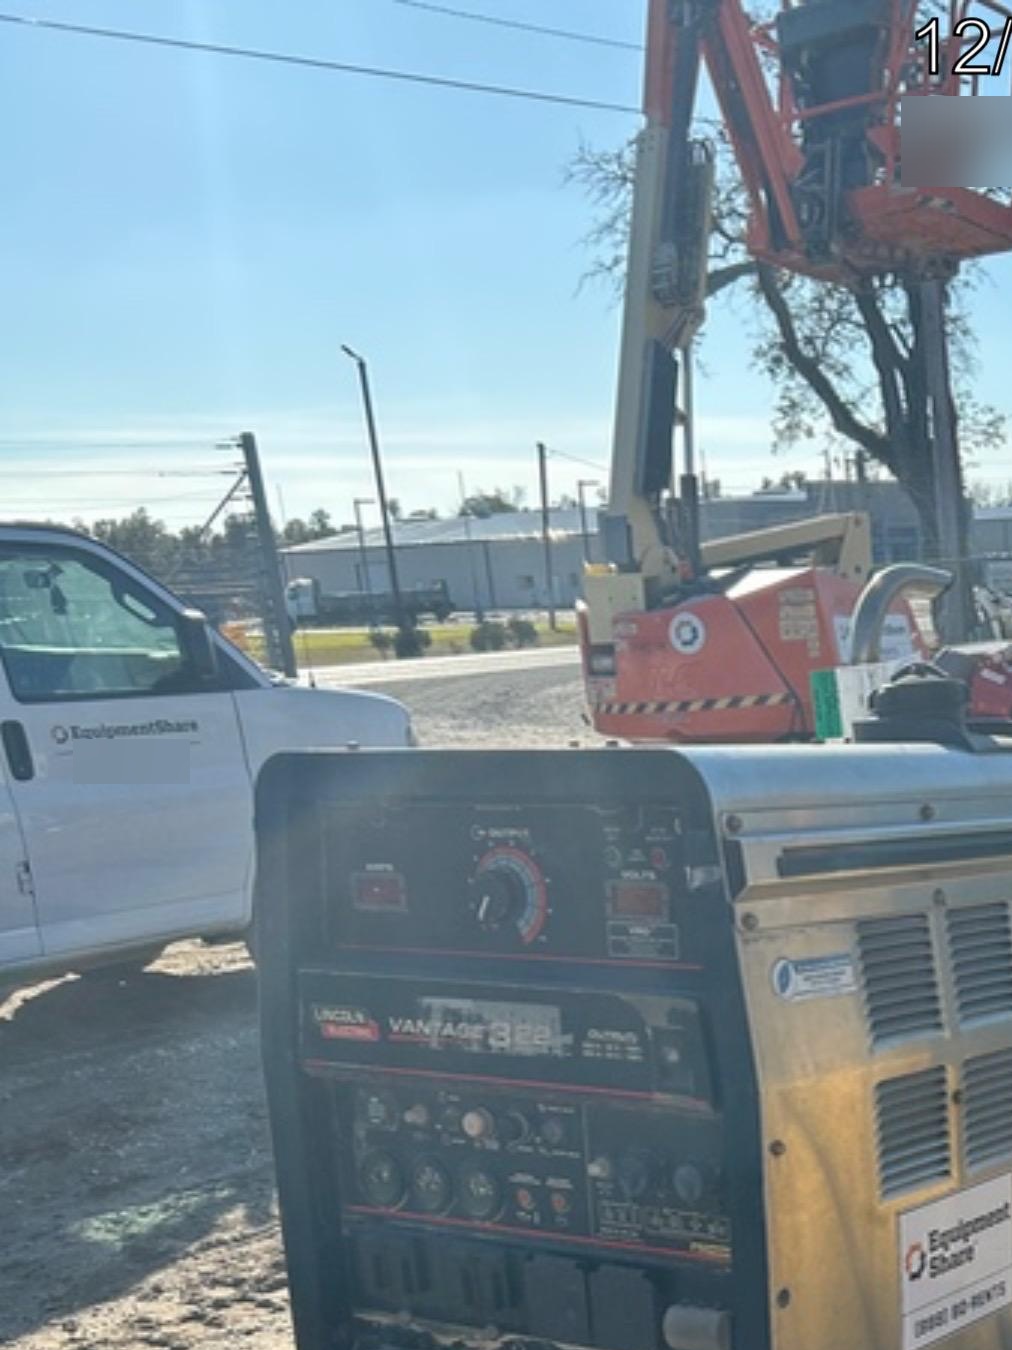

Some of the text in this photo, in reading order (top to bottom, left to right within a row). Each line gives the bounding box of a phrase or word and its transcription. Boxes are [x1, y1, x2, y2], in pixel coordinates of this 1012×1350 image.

[389, 1015, 483, 1040] VANTAGE
[928, 1201, 1011, 1253] Equipment
[929, 1245, 976, 1280] Share
